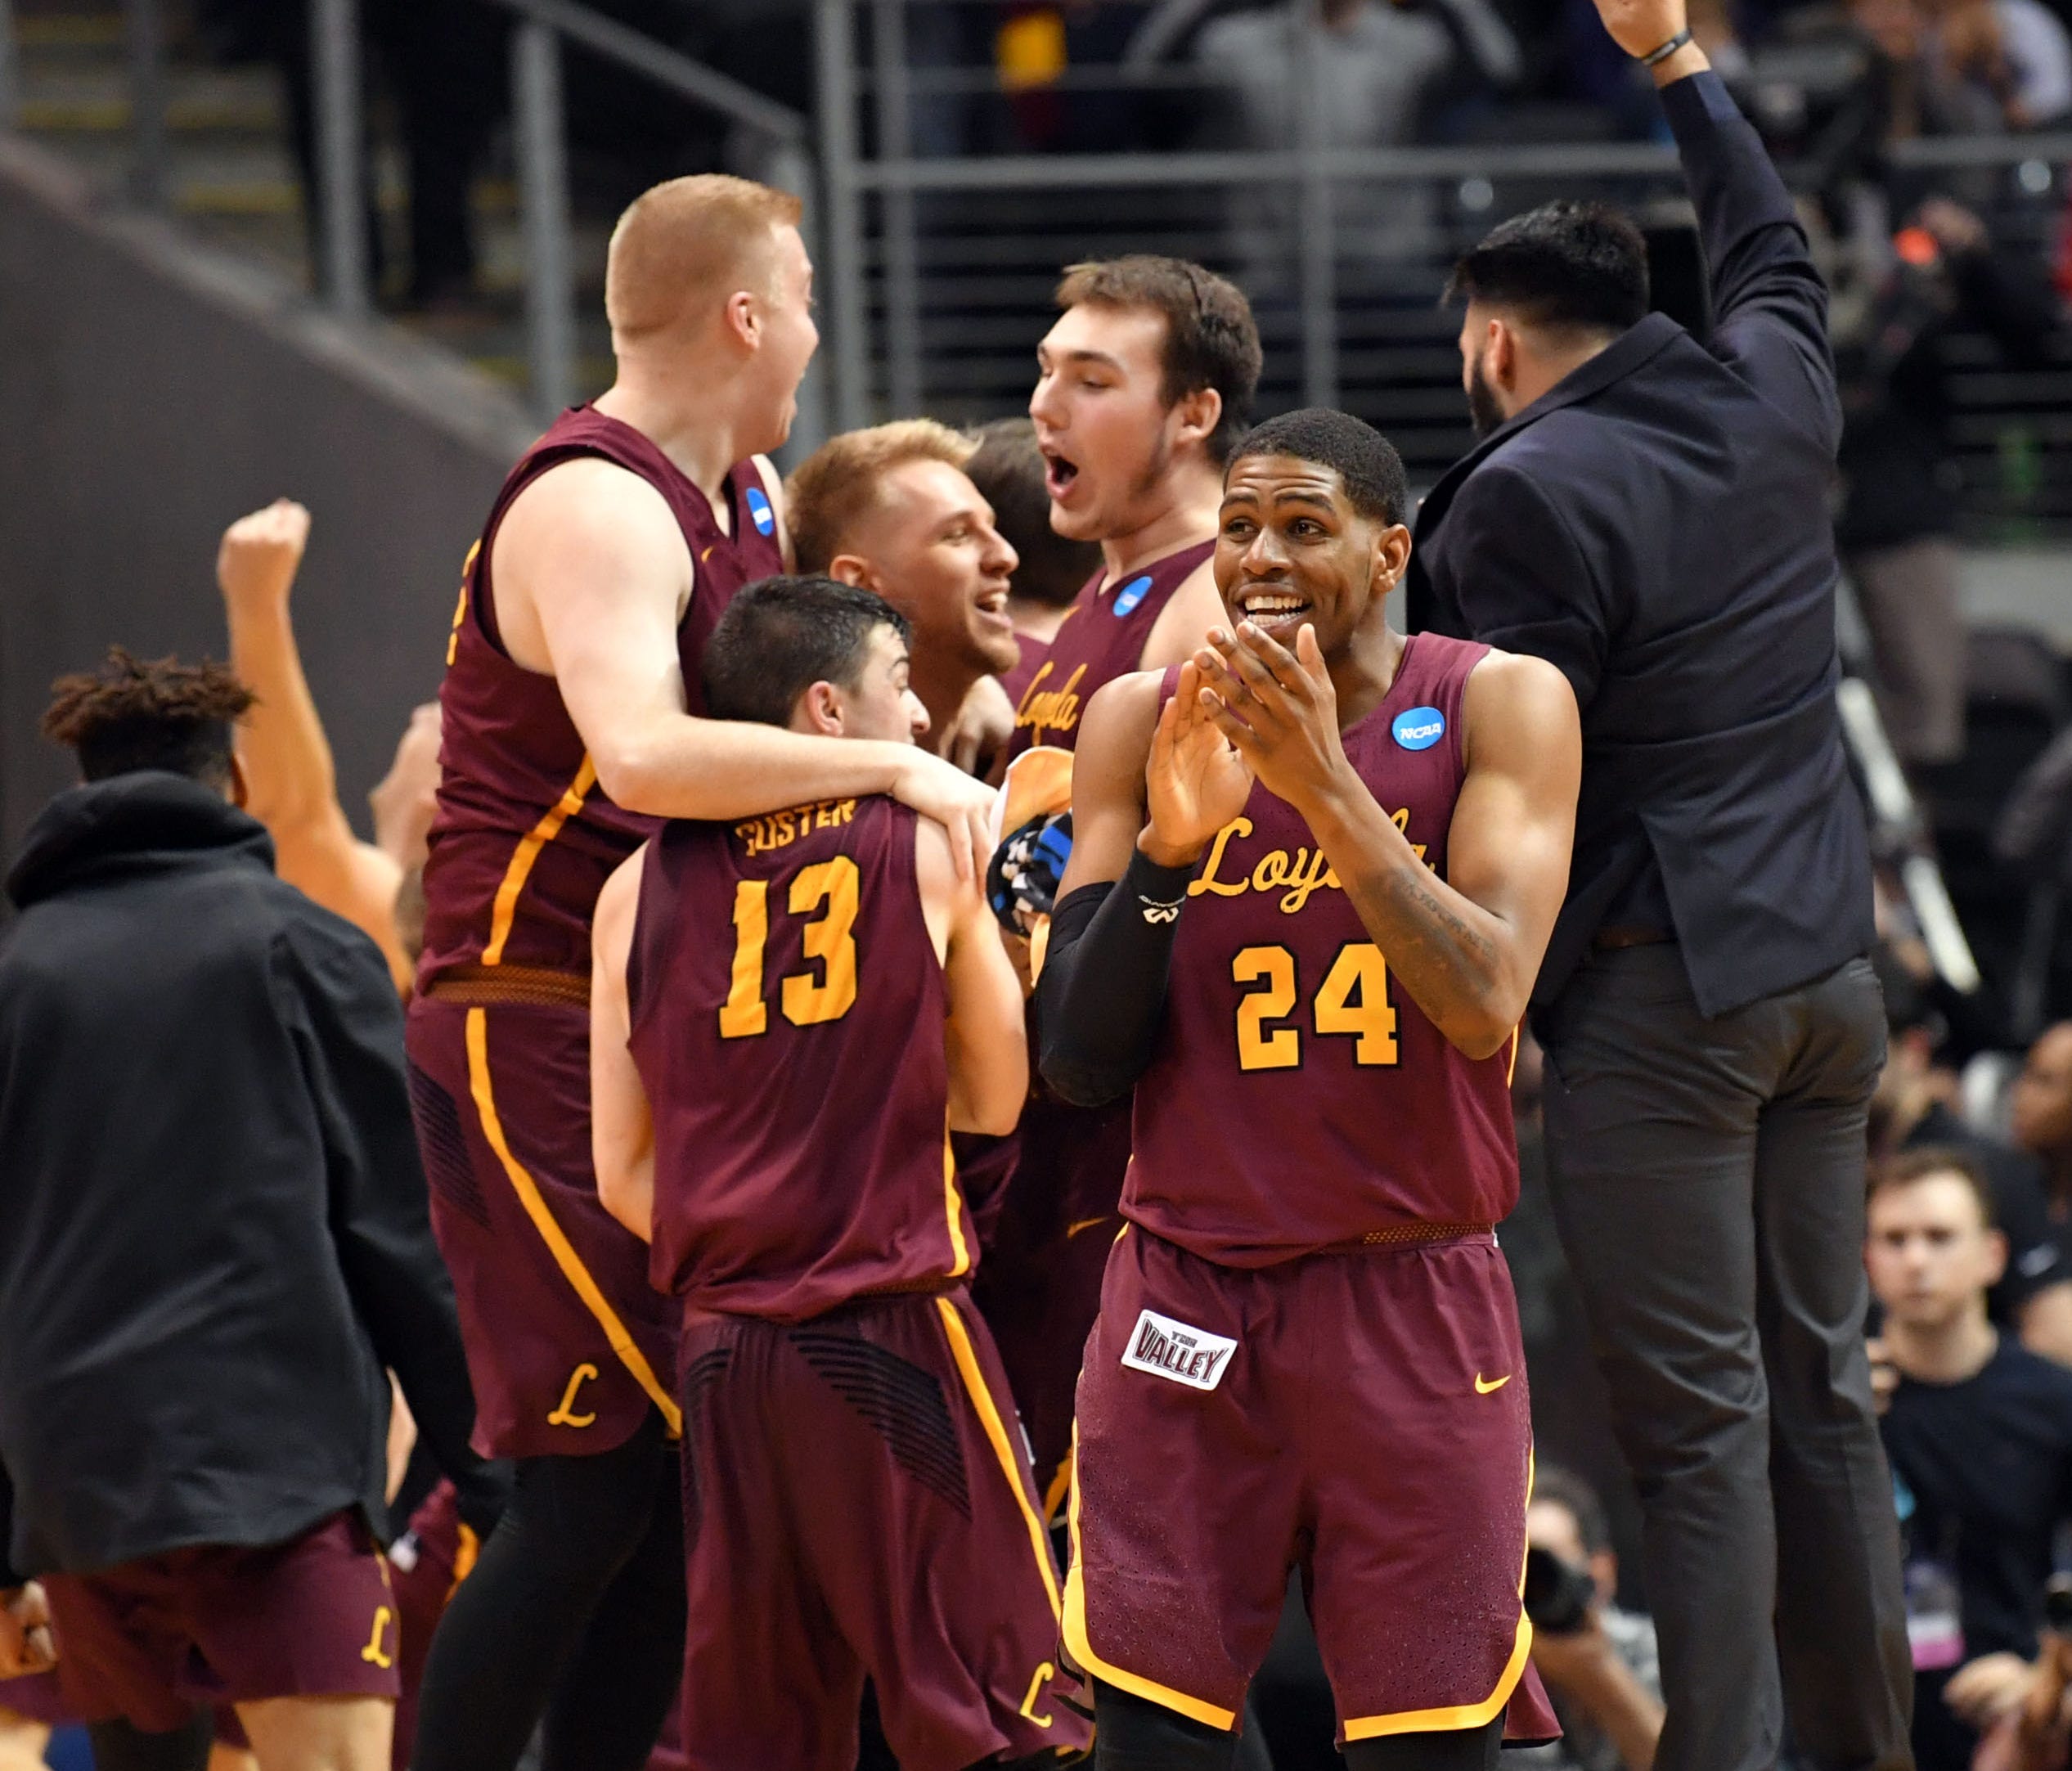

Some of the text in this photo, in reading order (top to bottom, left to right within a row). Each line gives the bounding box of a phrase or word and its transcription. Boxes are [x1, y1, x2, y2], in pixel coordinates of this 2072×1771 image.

[1400, 722, 1441, 740] NCAA
[719, 855, 860, 1039] 13
[1232, 942, 1398, 1070] 24
[1132, 1318, 1229, 1383] VALLEY
